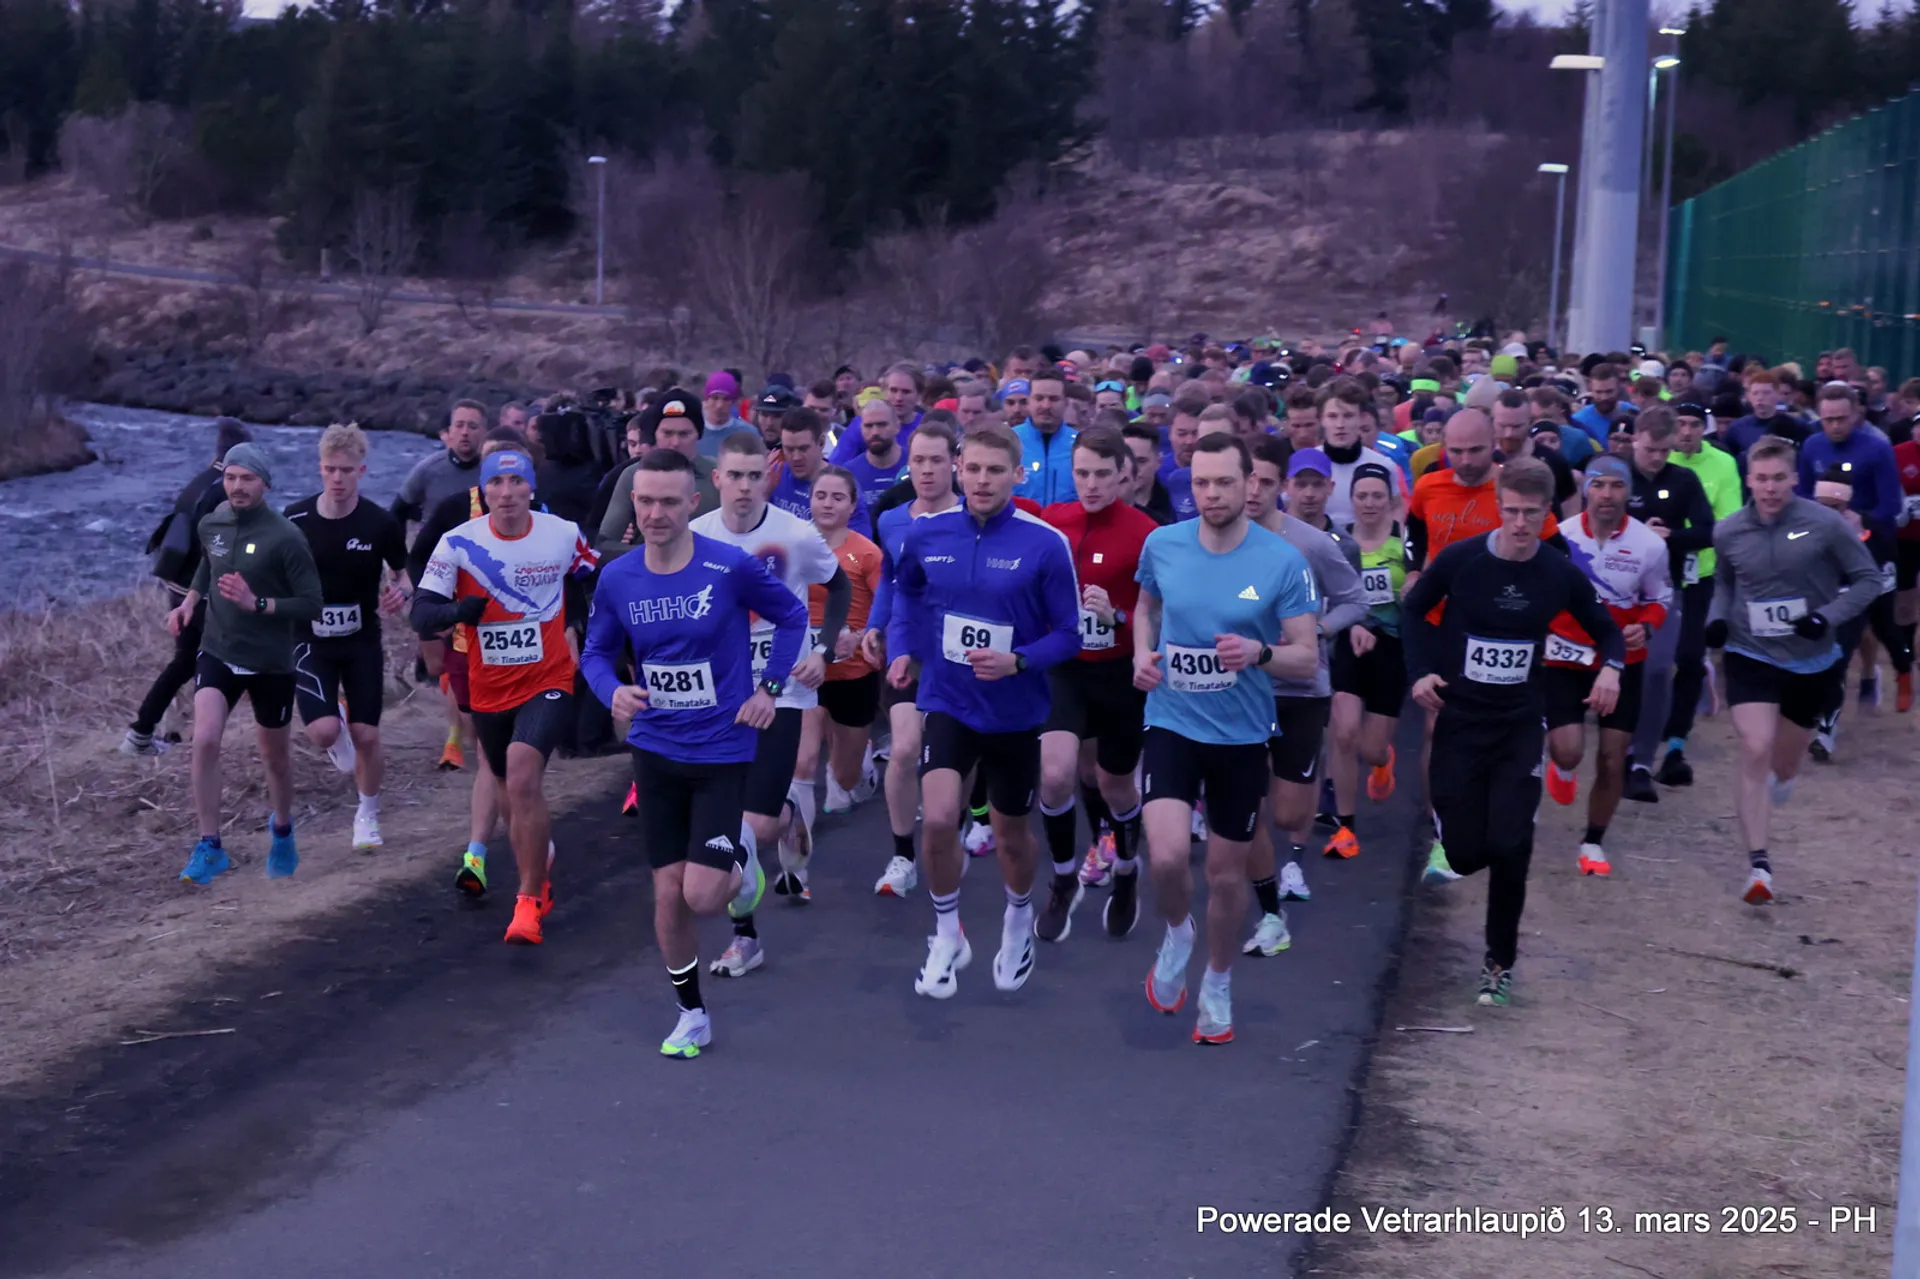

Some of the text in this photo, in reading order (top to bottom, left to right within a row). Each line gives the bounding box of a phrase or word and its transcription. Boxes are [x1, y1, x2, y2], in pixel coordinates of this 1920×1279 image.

[703, 561, 725, 572] CRAFT
[1764, 605, 1790, 623] 10
[482, 627, 537, 651] 2542
[961, 625, 991, 649] 69
[501, 654, 538, 664] Timataka
[1471, 646, 1529, 668] 4332
[650, 669, 705, 693] 4281
[1486, 673, 1524, 683] Timataka
[1189, 680, 1232, 691] Timataka
[668, 699, 711, 708] Timataka
